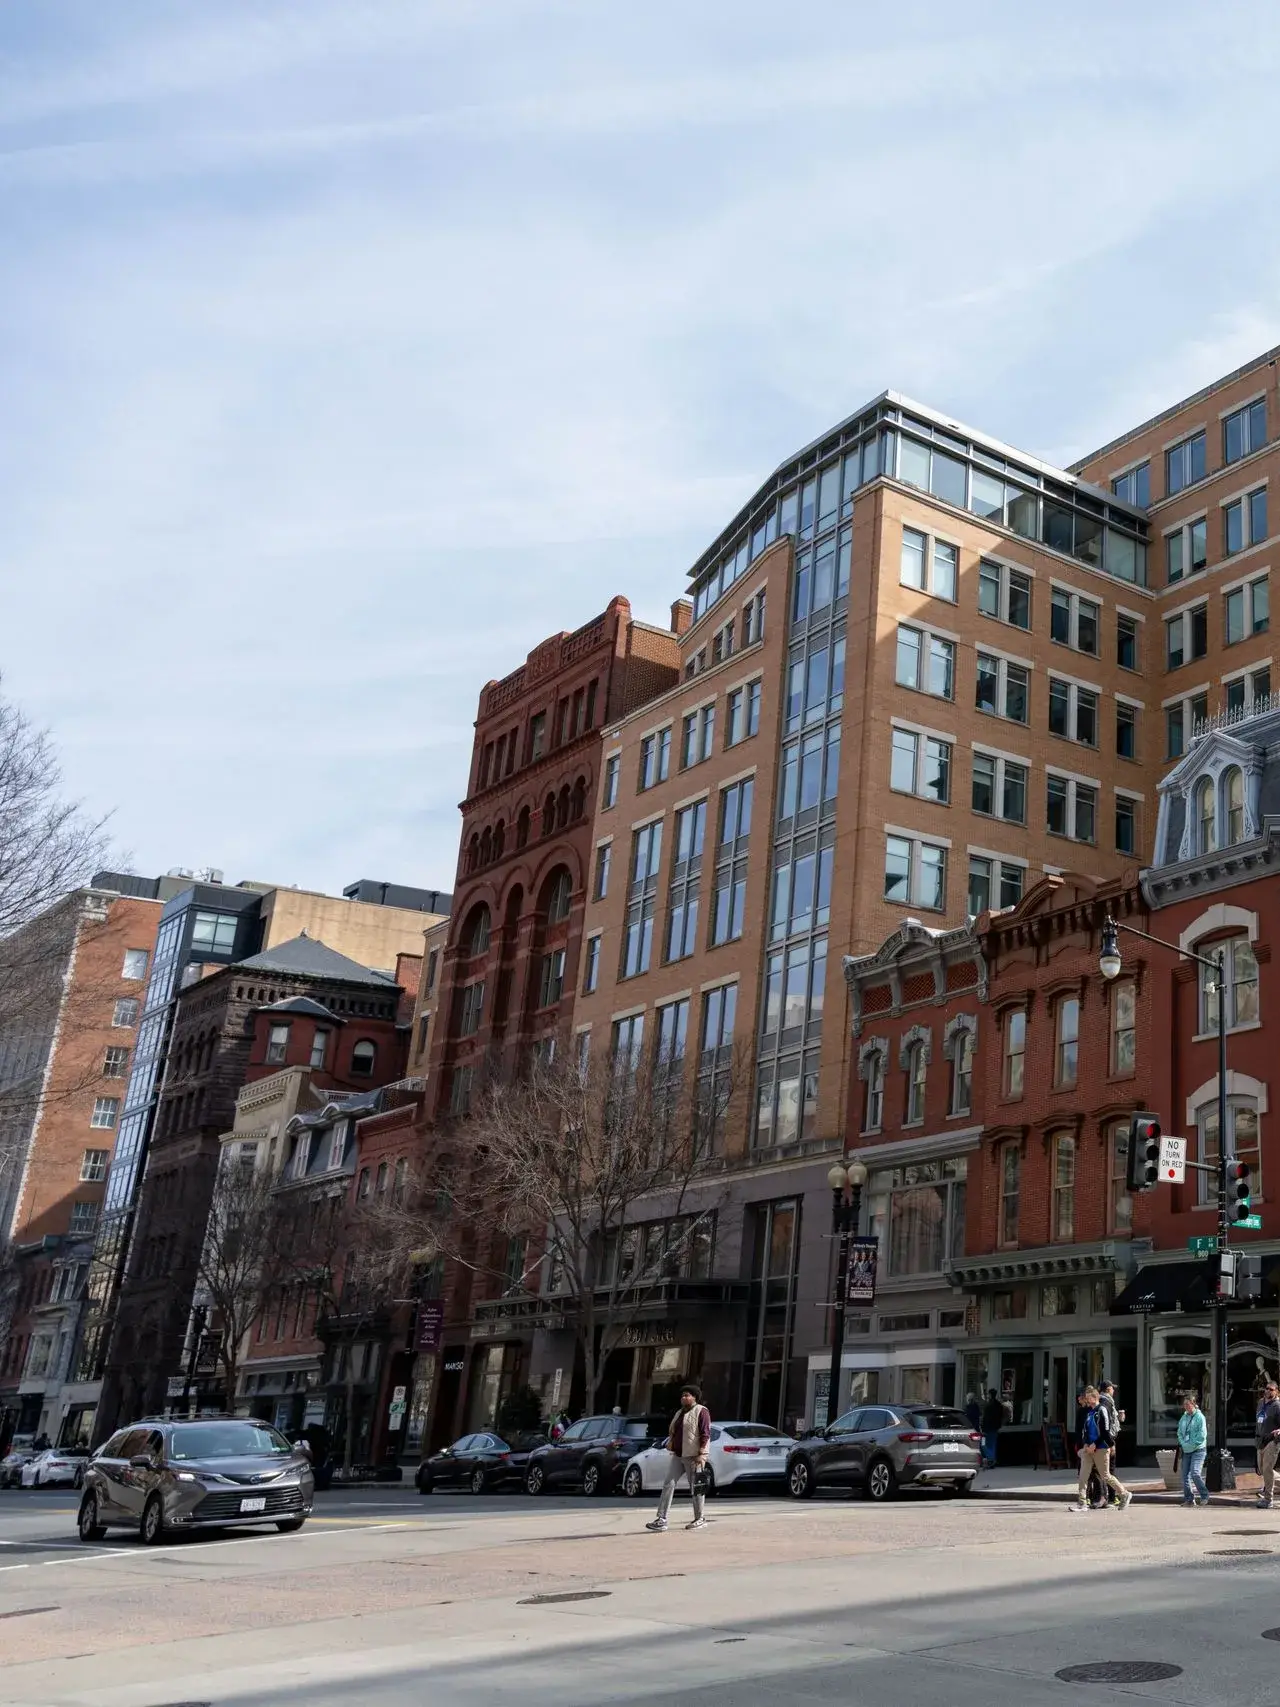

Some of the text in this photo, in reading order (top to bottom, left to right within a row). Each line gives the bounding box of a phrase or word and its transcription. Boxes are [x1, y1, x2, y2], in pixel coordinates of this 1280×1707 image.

[1167, 1140, 1179, 1150] NO
[1165, 1150, 1180, 1159] TURN
[1161, 1159, 1183, 1169] ON RED
[1196, 1238, 1203, 1249] F
